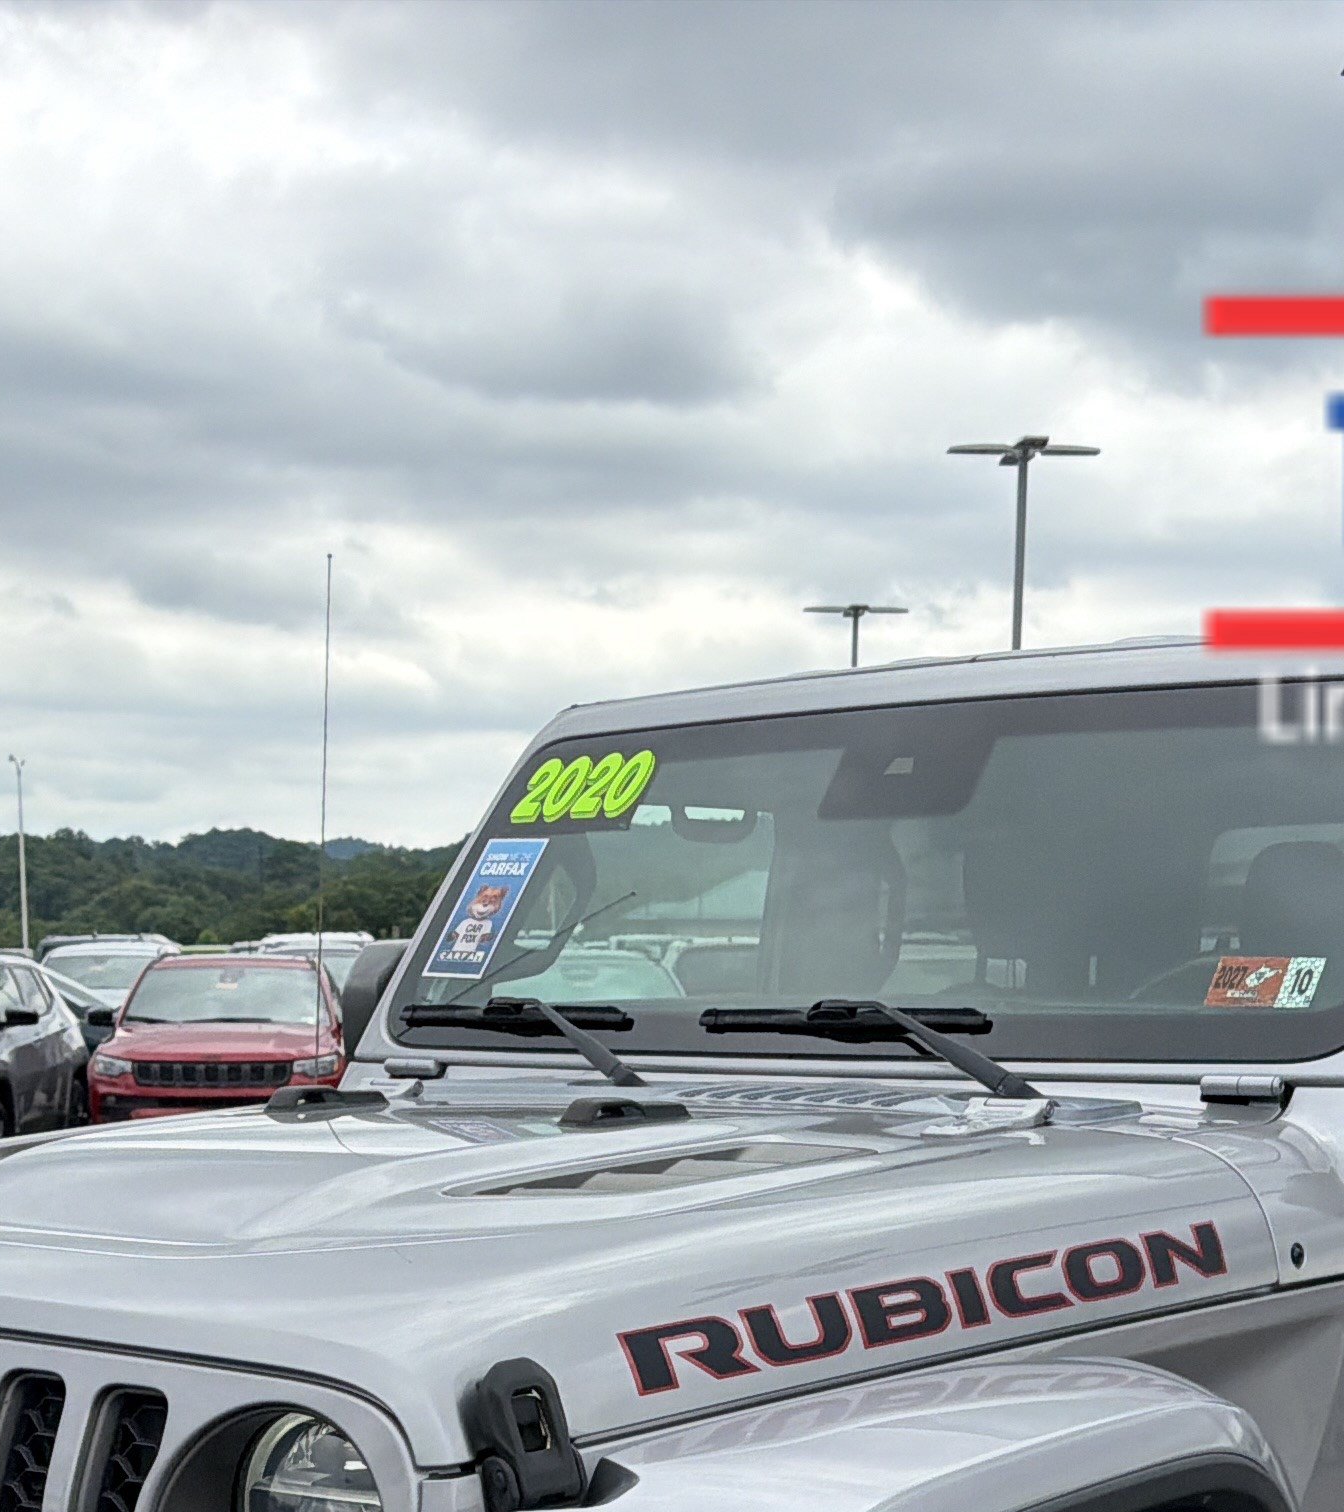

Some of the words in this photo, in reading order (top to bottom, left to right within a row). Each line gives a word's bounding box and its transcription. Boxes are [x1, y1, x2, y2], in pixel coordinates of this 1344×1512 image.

[510, 750, 655, 823] 2020
[479, 862, 530, 876] CARFAX
[465, 924, 484, 932] CAR
[1214, 965, 1249, 990] 2027
[1290, 969, 1314, 996] 10
[616, 1220, 1228, 1397] RUBICON
